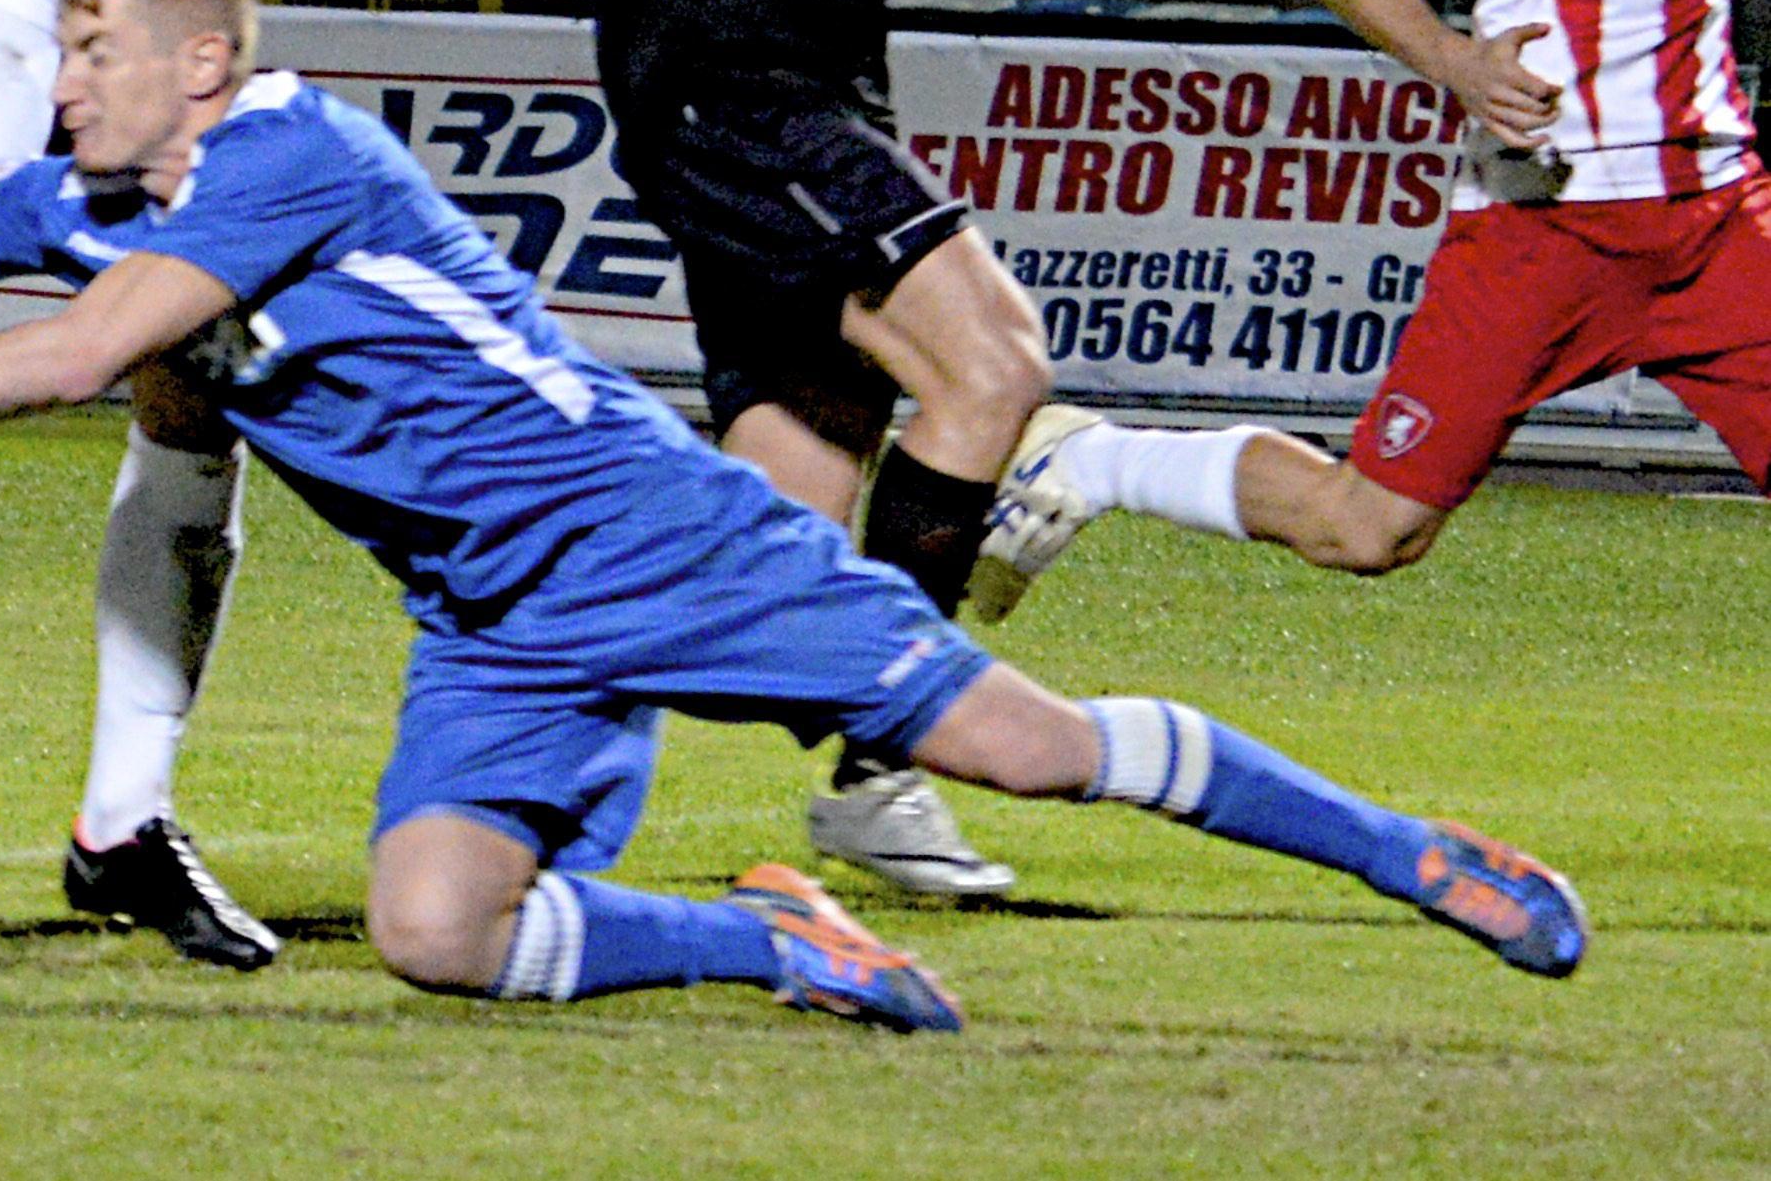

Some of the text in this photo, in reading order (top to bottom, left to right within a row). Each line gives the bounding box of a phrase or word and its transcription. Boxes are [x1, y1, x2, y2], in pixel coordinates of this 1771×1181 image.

[986, 63, 1270, 137] ADESSO
[1193, 146, 1462, 229] REVIS
[1247, 249, 1315, 298] 33
[1042, 297, 1215, 366] 0564
